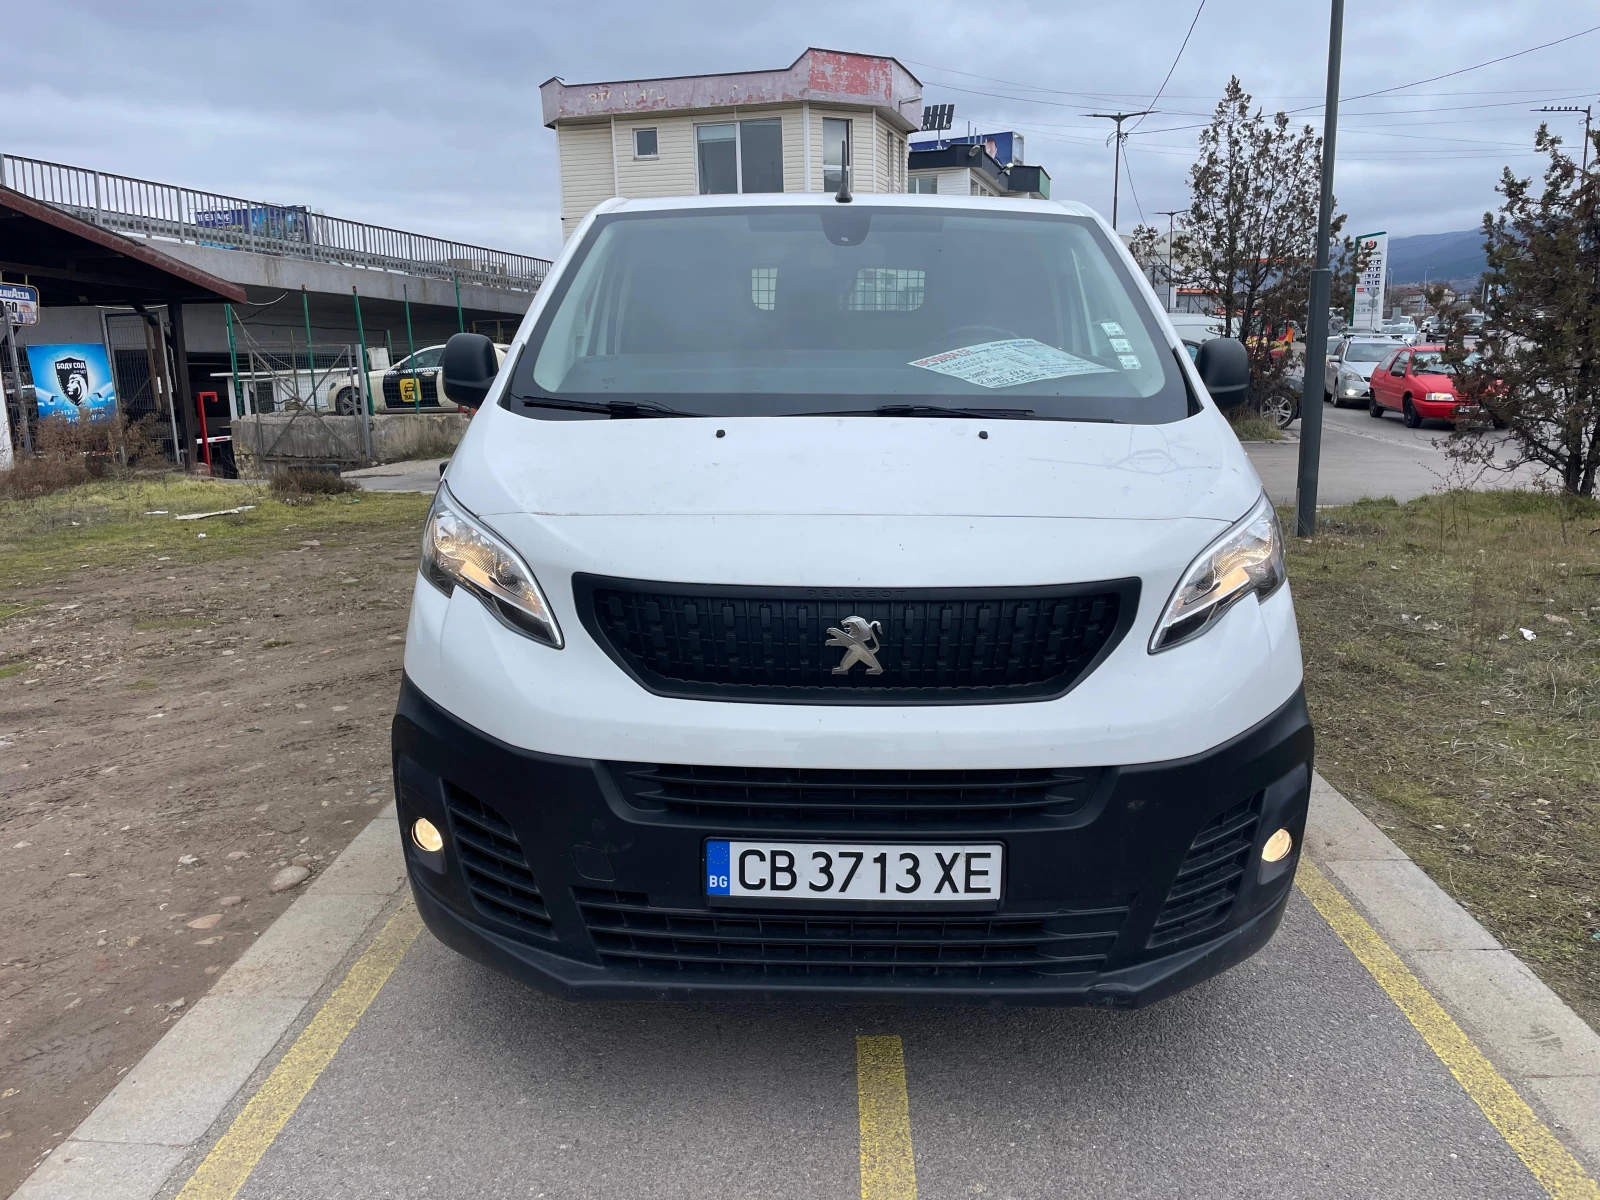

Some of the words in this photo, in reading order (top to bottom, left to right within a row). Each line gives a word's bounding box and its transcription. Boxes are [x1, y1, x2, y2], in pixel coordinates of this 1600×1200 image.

[56, 362, 73, 370] БОДУ
[807, 589, 906, 599] PEUGEOT
[709, 875, 728, 888] BG
[738, 849, 797, 891] CB
[808, 851, 921, 893] 3713
[934, 852, 992, 894] XE
